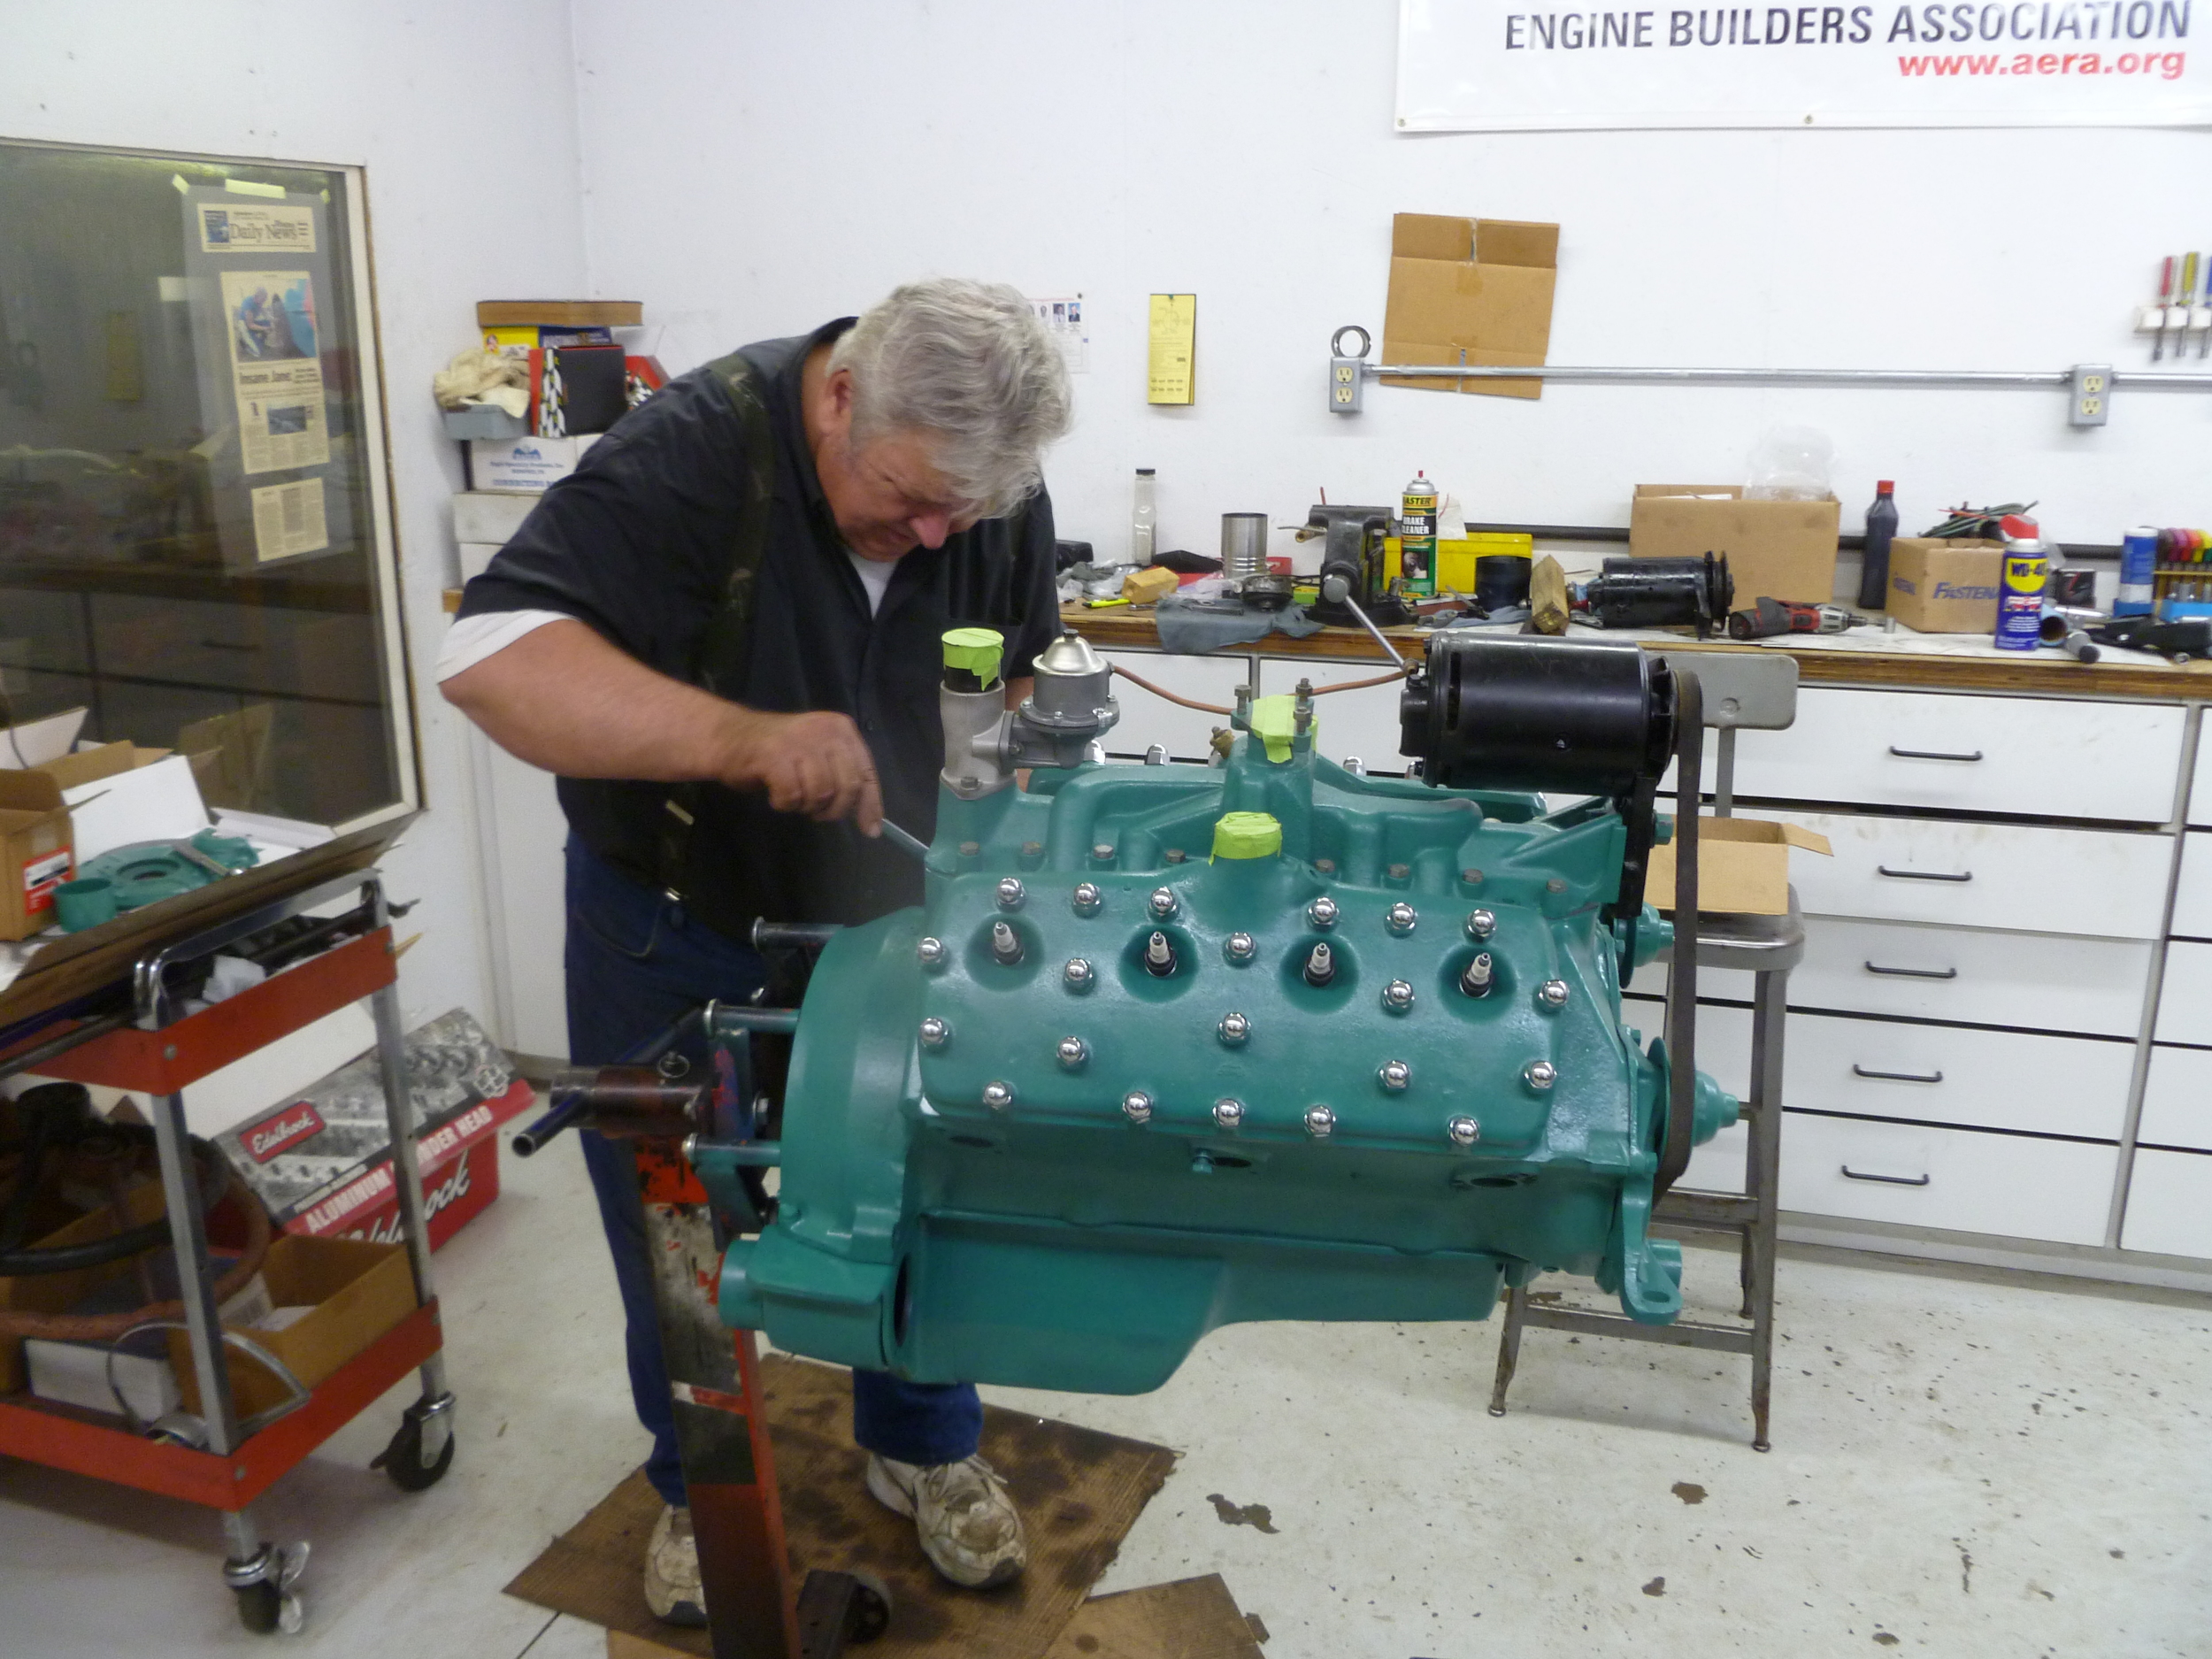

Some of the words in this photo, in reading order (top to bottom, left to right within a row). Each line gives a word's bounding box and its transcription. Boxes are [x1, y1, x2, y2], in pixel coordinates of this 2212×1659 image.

[1505, 11, 1655, 50] ENGINE
[1669, 5, 1874, 48] BUILDERS
[1886, 0, 2192, 43] ASSOCIATION
[1896, 50, 2187, 81] www.aera.org
[229, 223, 263, 242] Daily
[1403, 496, 1432, 505] ASTER
[1402, 516, 1425, 526] BRAKE
[1402, 526, 1430, 534] CLEANER
[251, 1110, 316, 1155] Edelbrock
[305, 1166, 393, 1234] ALUMINUM
[454, 1105, 494, 1138] HEAD
